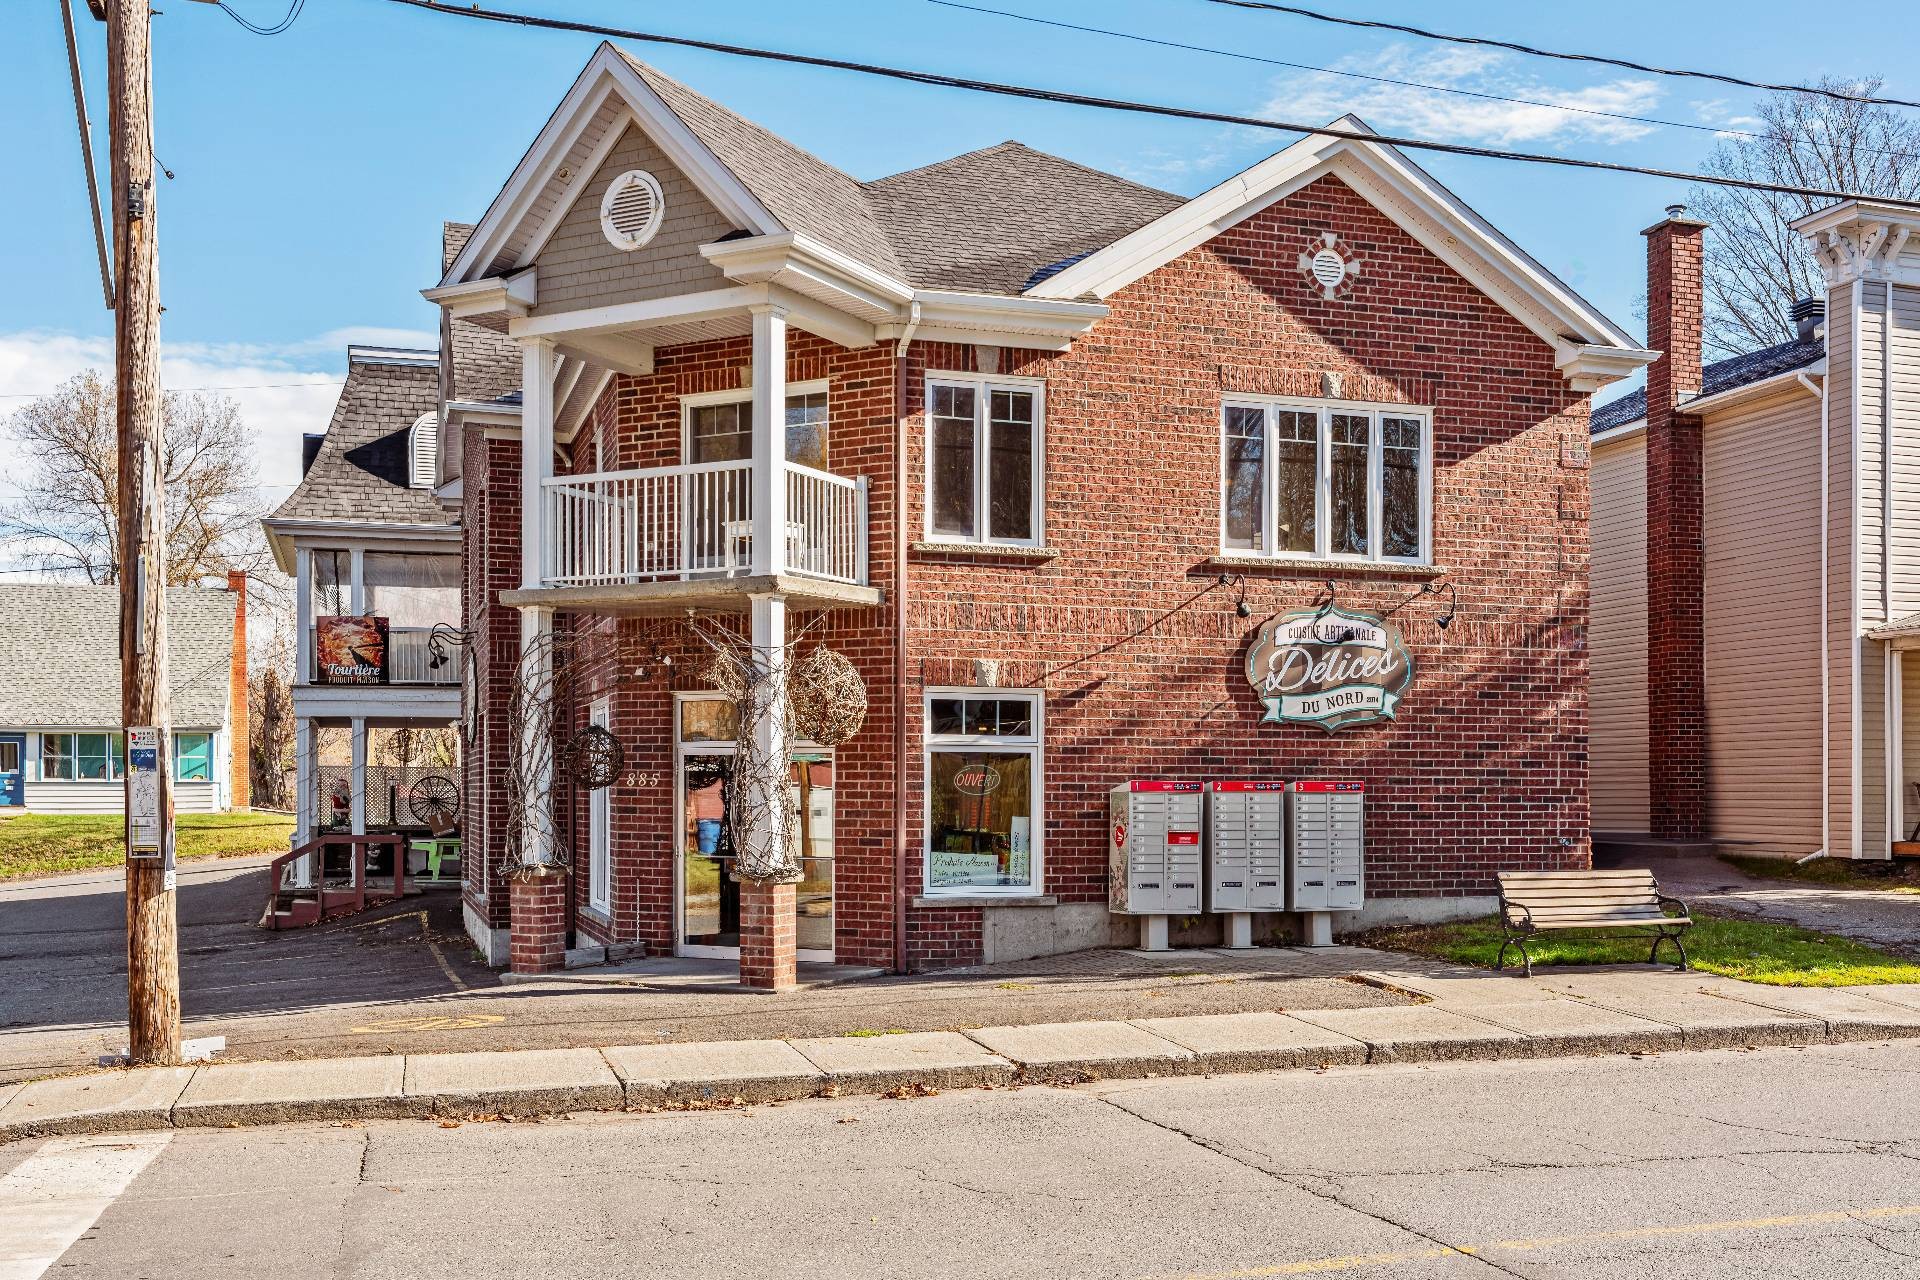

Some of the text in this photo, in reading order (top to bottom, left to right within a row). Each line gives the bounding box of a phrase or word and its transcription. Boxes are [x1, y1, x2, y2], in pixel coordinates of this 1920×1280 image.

[1324, 624, 1377, 641] ARTIANALE
[327, 662, 381, 676] Tourtière
[1265, 646, 1399, 691] Délices
[1301, 700, 1320, 714] DU
[1325, 691, 1364, 710] NORD
[626, 773, 660, 787] 885
[956, 773, 998, 787] OUVERT
[1216, 782, 1222, 791] 2
[1298, 782, 1304, 791] 3
